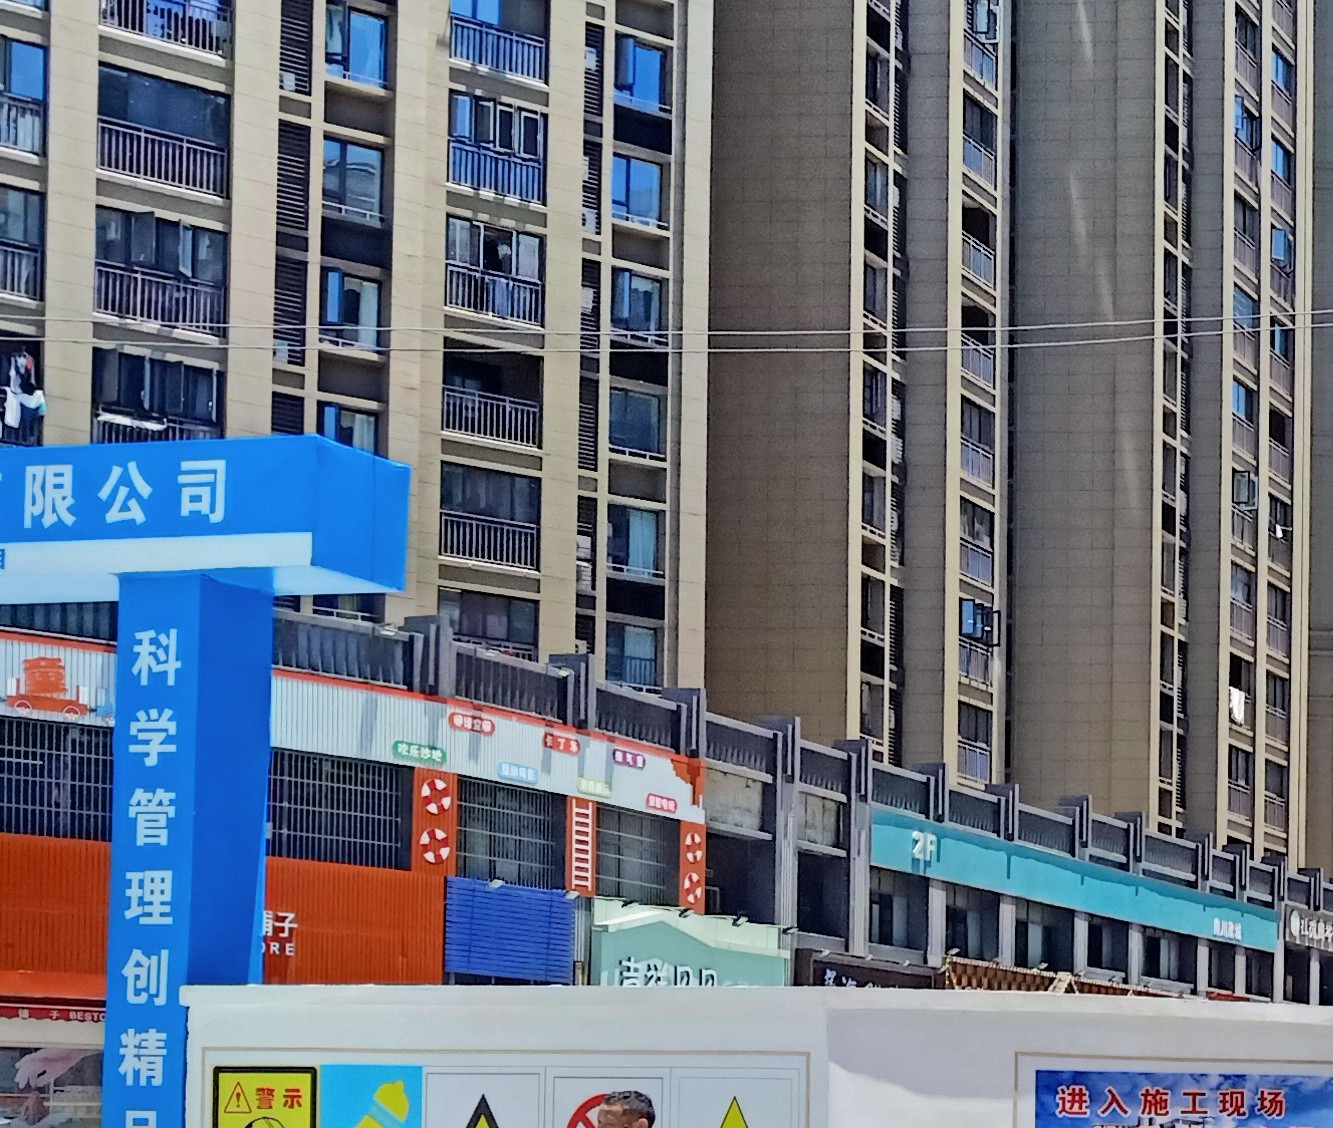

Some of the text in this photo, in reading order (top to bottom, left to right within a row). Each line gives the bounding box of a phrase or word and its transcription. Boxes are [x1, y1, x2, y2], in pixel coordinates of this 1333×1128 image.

[0, 457, 227, 528] 限公司
[911, 830, 937, 861] 2F
[255, 1087, 303, 1109] 警示
[1057, 1085, 1286, 1118] 进入施工现场
